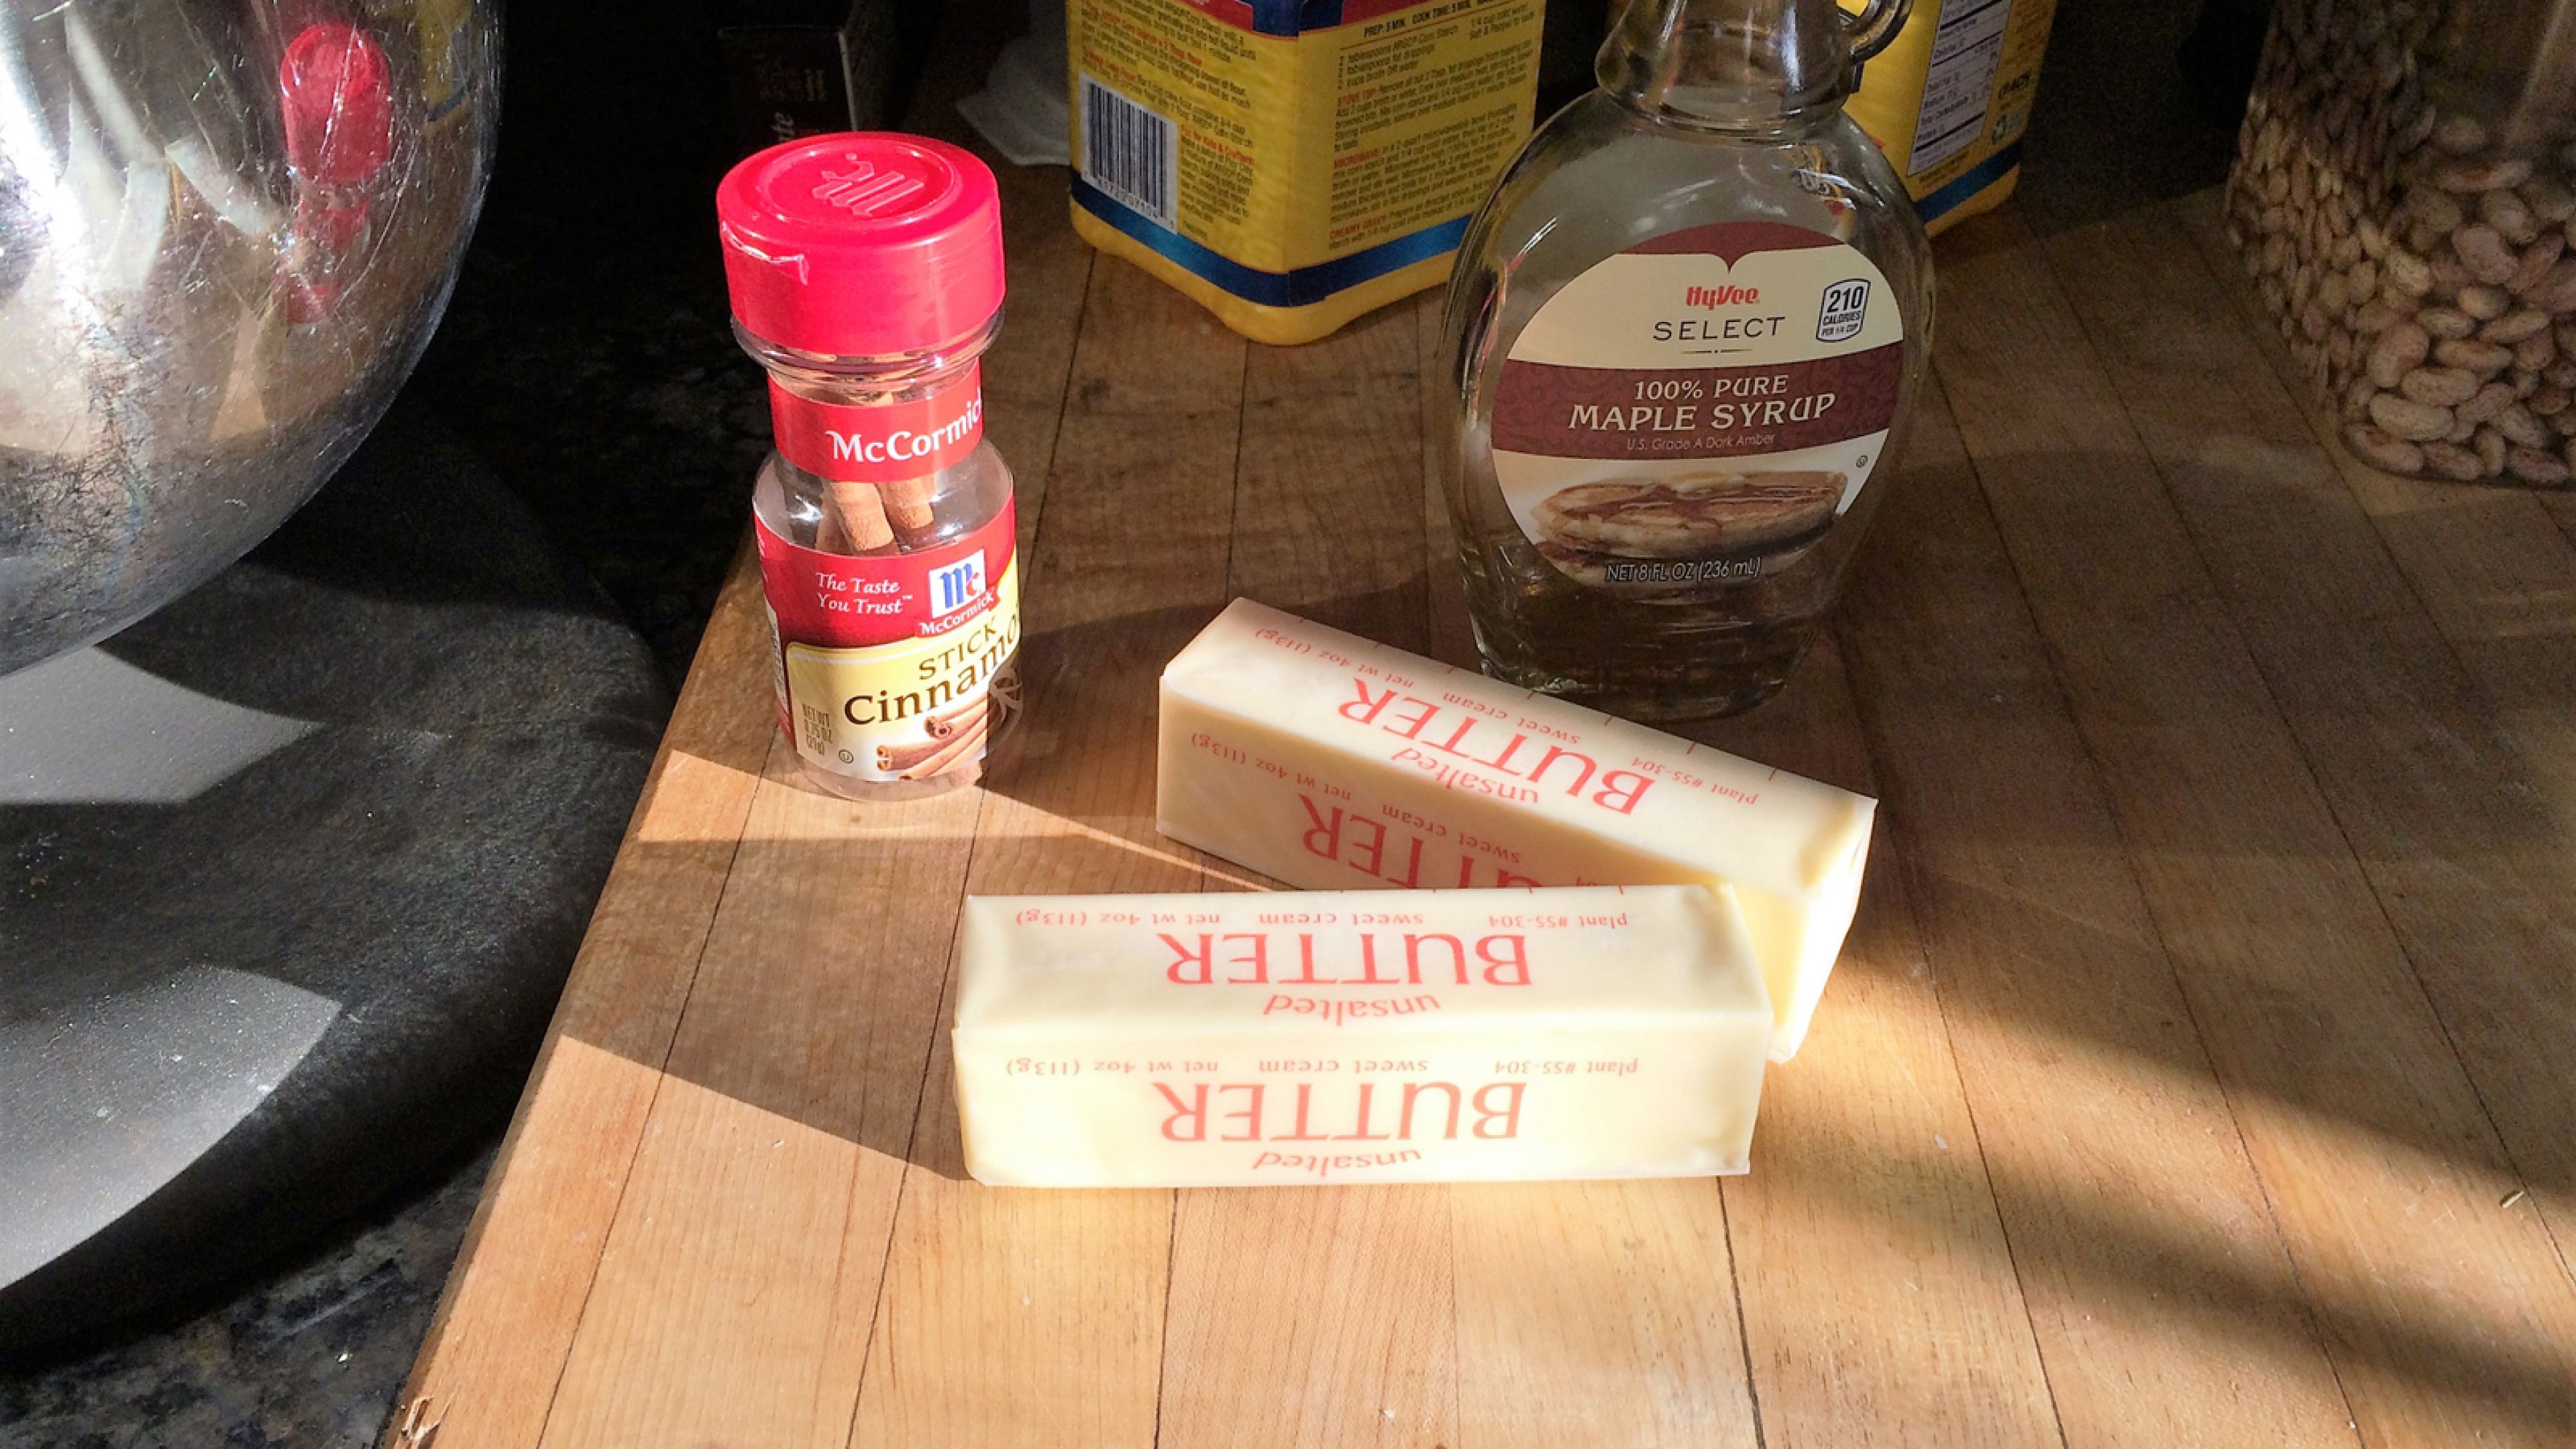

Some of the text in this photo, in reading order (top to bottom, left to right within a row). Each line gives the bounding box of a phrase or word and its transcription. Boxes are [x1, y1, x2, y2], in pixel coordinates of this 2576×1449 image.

[1686, 285, 1759, 311] HyVee
[1827, 286, 1864, 313] 210
[1653, 316, 1786, 341] SELECT
[1634, 374, 1790, 400] 100% PURE
[825, 386, 983, 463] McCormic
[1568, 392, 1837, 431] MAPLE SYRUP
[1627, 431, 1776, 451] U.S. Grade A Dark Amber
[816, 572, 900, 594] The Taste
[1606, 557, 1762, 582] NET 8 FL OZ (236 mL)
[816, 593, 851, 612] You
[919, 590, 994, 635] McCormick
[919, 616, 997, 680] STICK
[844, 612, 1018, 725] Cinnamo
[1255, 628, 1759, 805] plant #55-304 sweet cream net wt 4oz (113g)
[1338, 676, 1655, 816] BUTTER
[1391, 747, 1540, 804] unsalted
[1191, 732, 1521, 864] sweet cream net wt 4oz (113g)
[1015, 908, 1628, 929] plant #55-304 sweet cream net wt 4oz (113g)
[1156, 932, 1533, 987] BUTTER
[1262, 994, 1442, 1027] unsalted
[1005, 1057, 1639, 1077] plant #55-304 sweet cream net wt 4oz (113g)
[1151, 1081, 1527, 1141] BUTTER
[1252, 1148, 1421, 1177] unsalted
